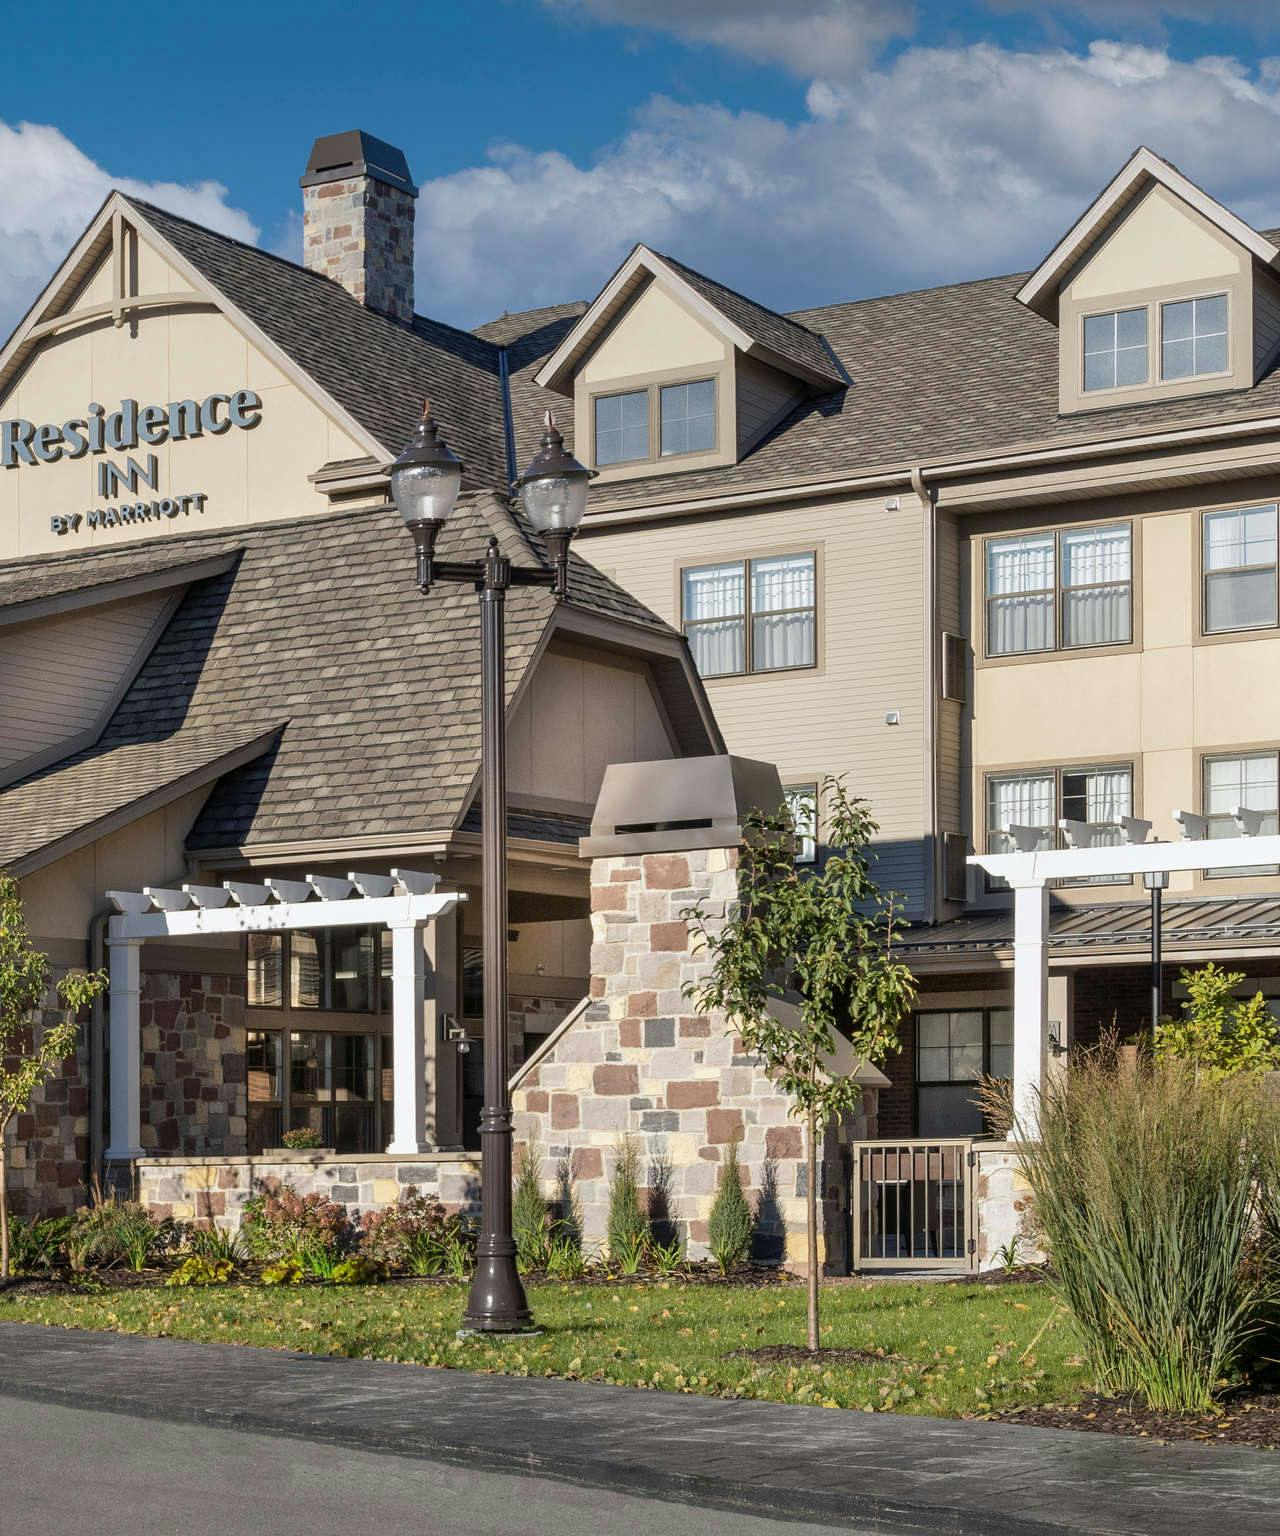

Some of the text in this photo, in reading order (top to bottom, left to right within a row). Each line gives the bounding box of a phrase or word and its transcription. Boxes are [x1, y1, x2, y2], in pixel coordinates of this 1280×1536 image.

[0, 389, 262, 469] Residence
[98, 454, 159, 499] INN
[50, 493, 208, 536] BY MARRIOTT
